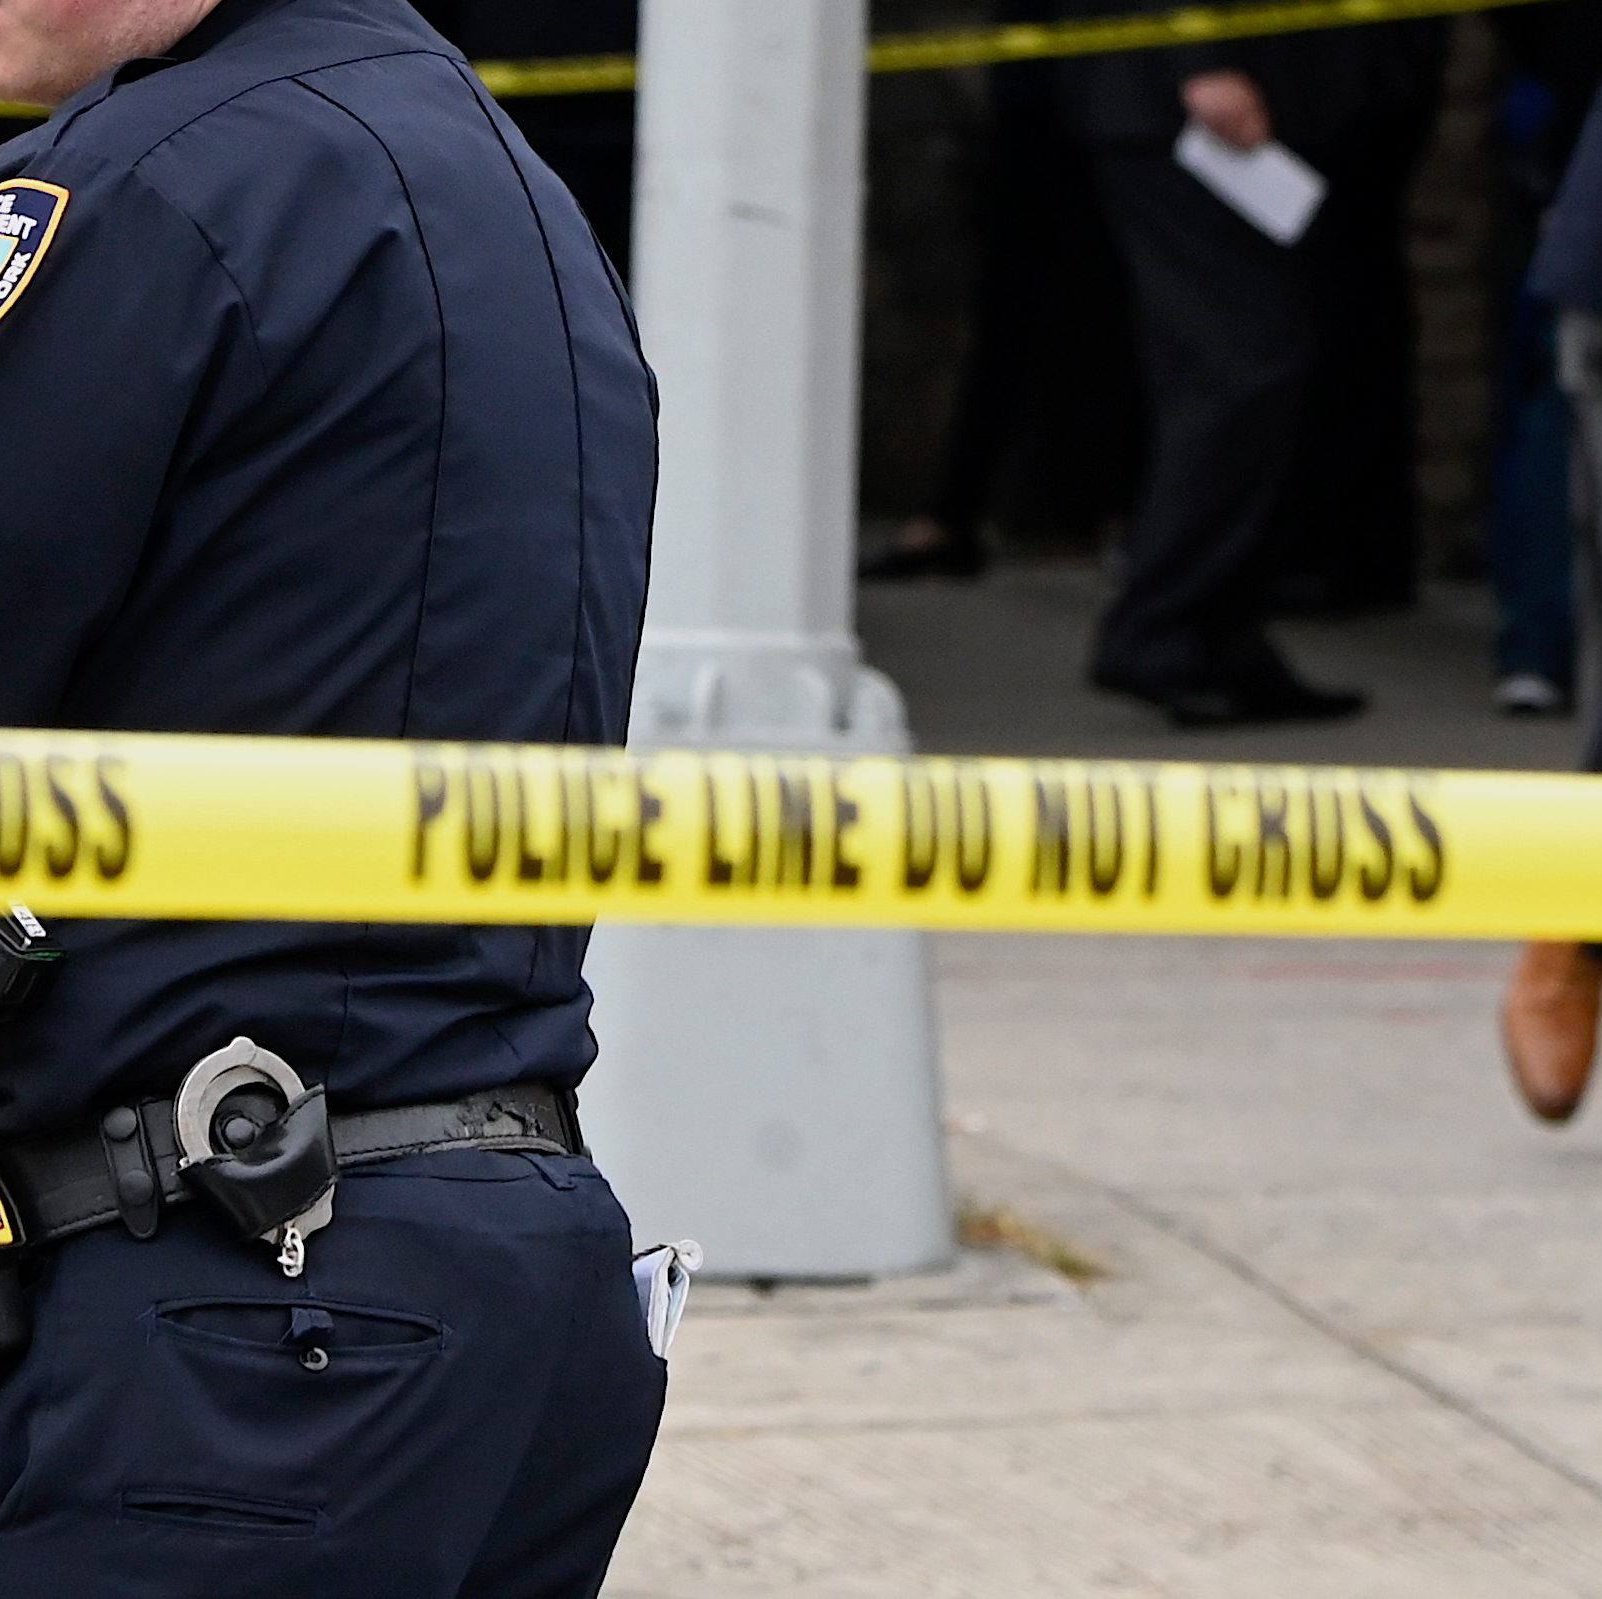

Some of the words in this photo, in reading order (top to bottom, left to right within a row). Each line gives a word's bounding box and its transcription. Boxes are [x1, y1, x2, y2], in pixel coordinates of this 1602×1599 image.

[406, 748, 665, 886] POLICE
[703, 752, 865, 889] LINE
[899, 756, 994, 892] DO
[1029, 761, 1162, 899] NOT
[1205, 769, 1445, 903] CROSS
